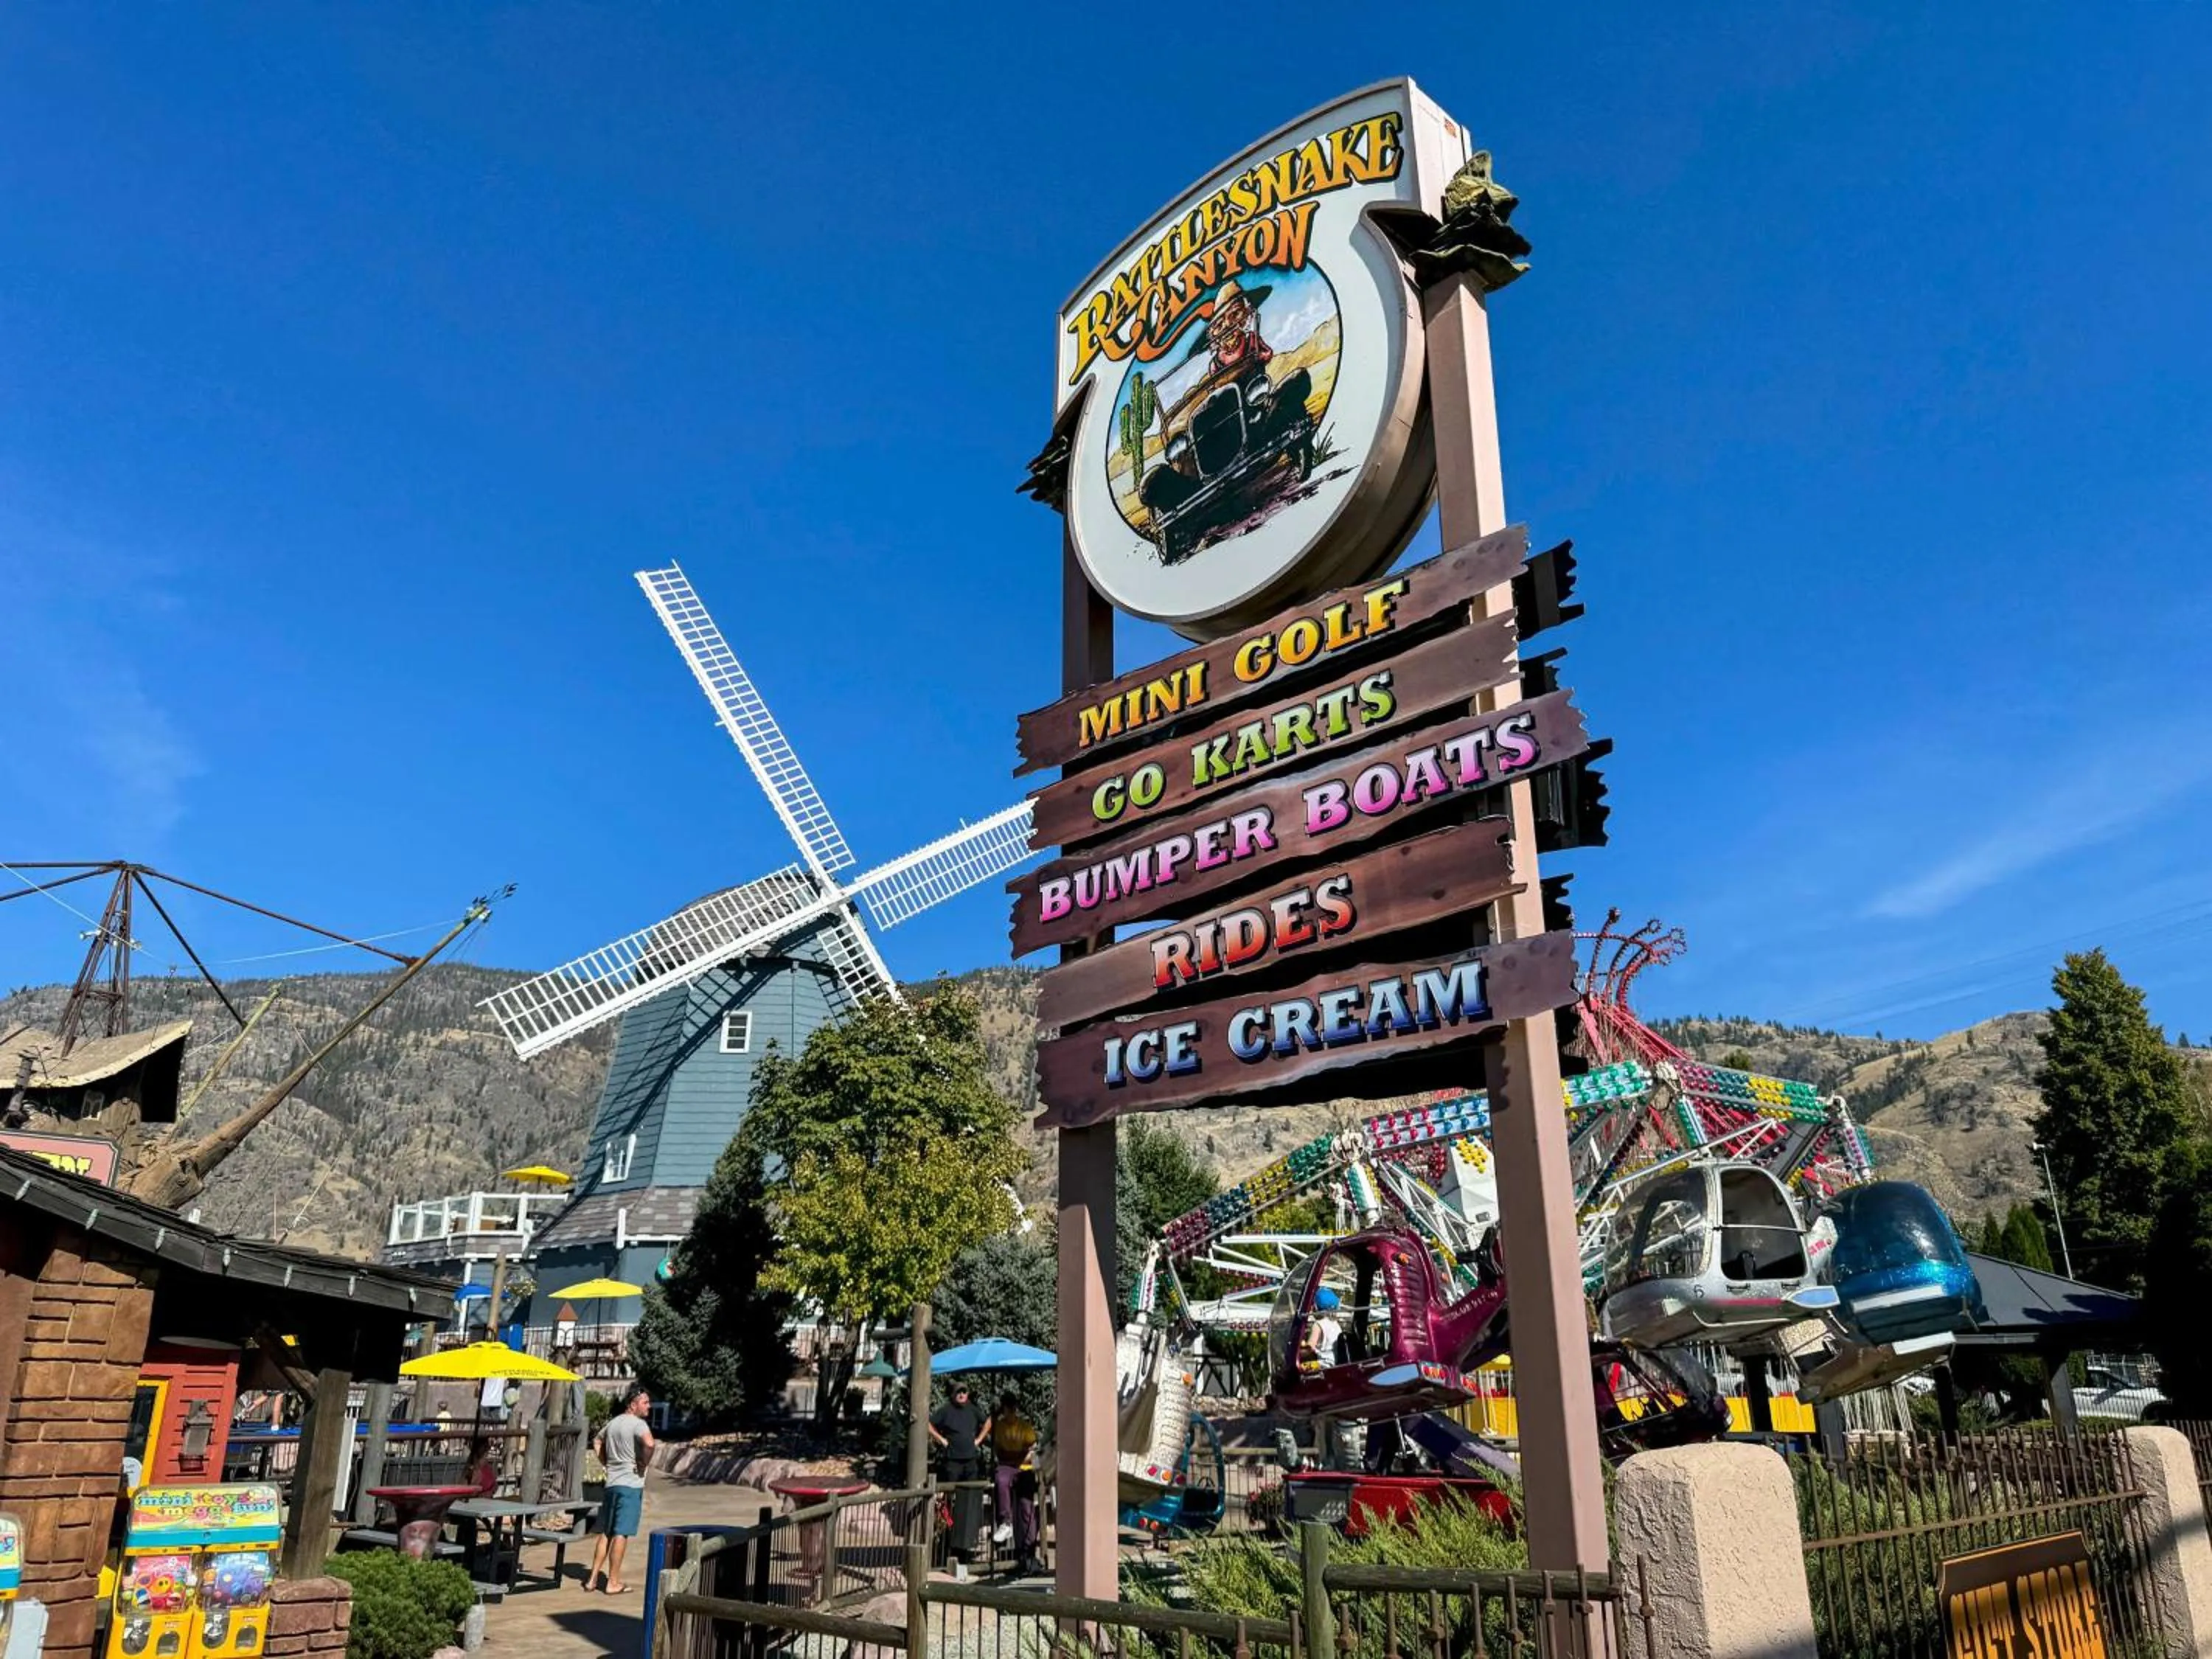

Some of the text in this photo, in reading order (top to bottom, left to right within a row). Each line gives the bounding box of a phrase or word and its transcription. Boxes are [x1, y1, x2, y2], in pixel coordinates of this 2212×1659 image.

[1068, 111, 1404, 385] RATTLESNAKE
[1133, 201, 1320, 363] CANYON
[1078, 577, 1410, 749] MINI GOLF
[1037, 710, 1540, 924] BUMPER BOATS
[1091, 669, 1397, 822] GO KARTS
[1150, 873, 1354, 992] RIDES
[1103, 959, 1490, 1088] ICE CREAM
